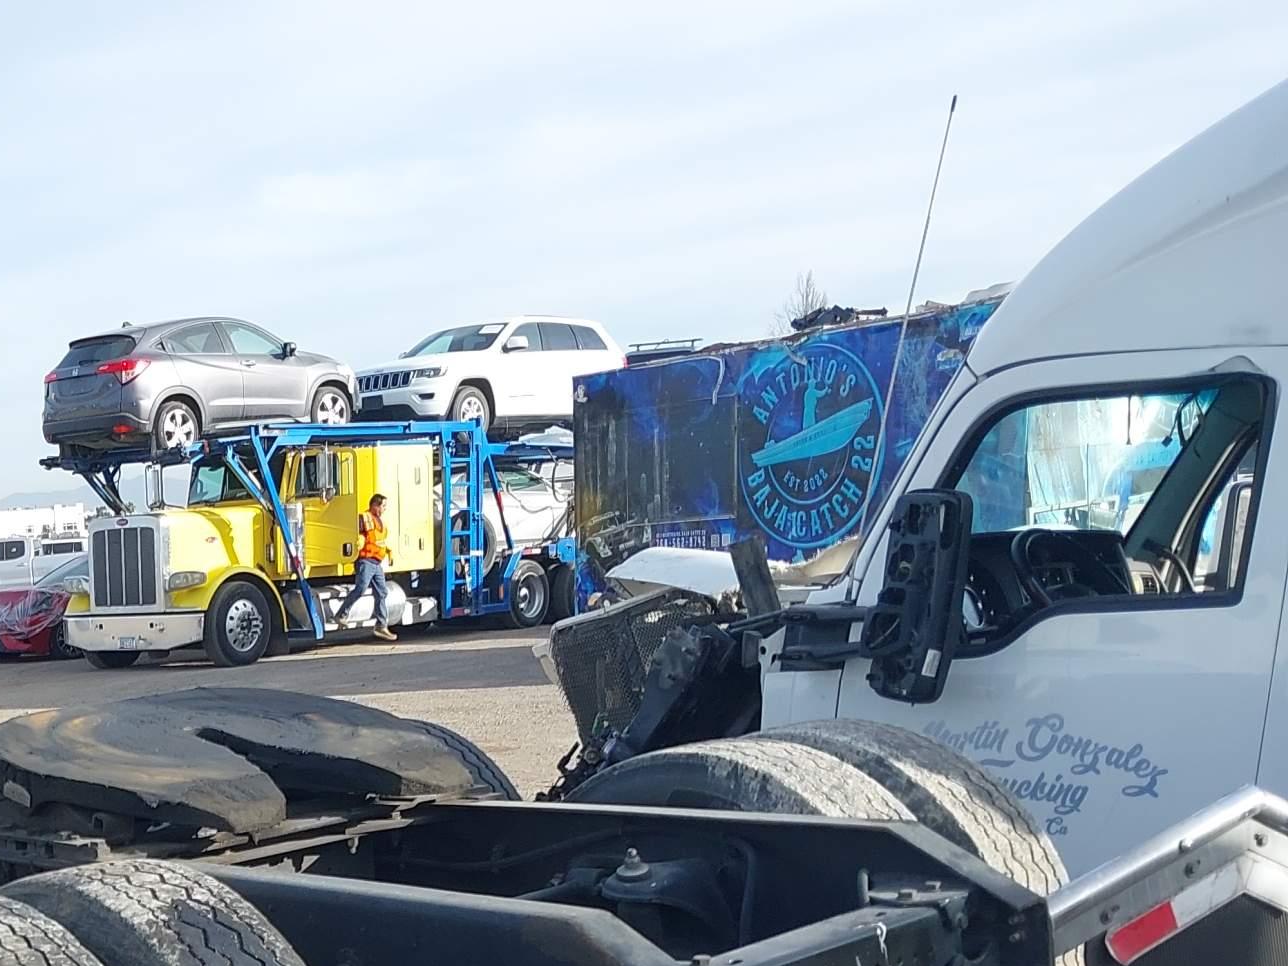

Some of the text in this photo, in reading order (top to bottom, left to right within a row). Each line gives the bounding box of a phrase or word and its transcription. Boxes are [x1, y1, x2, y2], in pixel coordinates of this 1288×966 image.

[753, 356, 856, 425] ANTONIO'S
[747, 468, 789, 532] BAJA
[851, 434, 875, 473] 22
[784, 468, 829, 493] EST 2022
[980, 758, 1089, 815] ucking
[1015, 713, 1169, 798] Gonzalez
[1046, 816, 1068, 836] Ca
